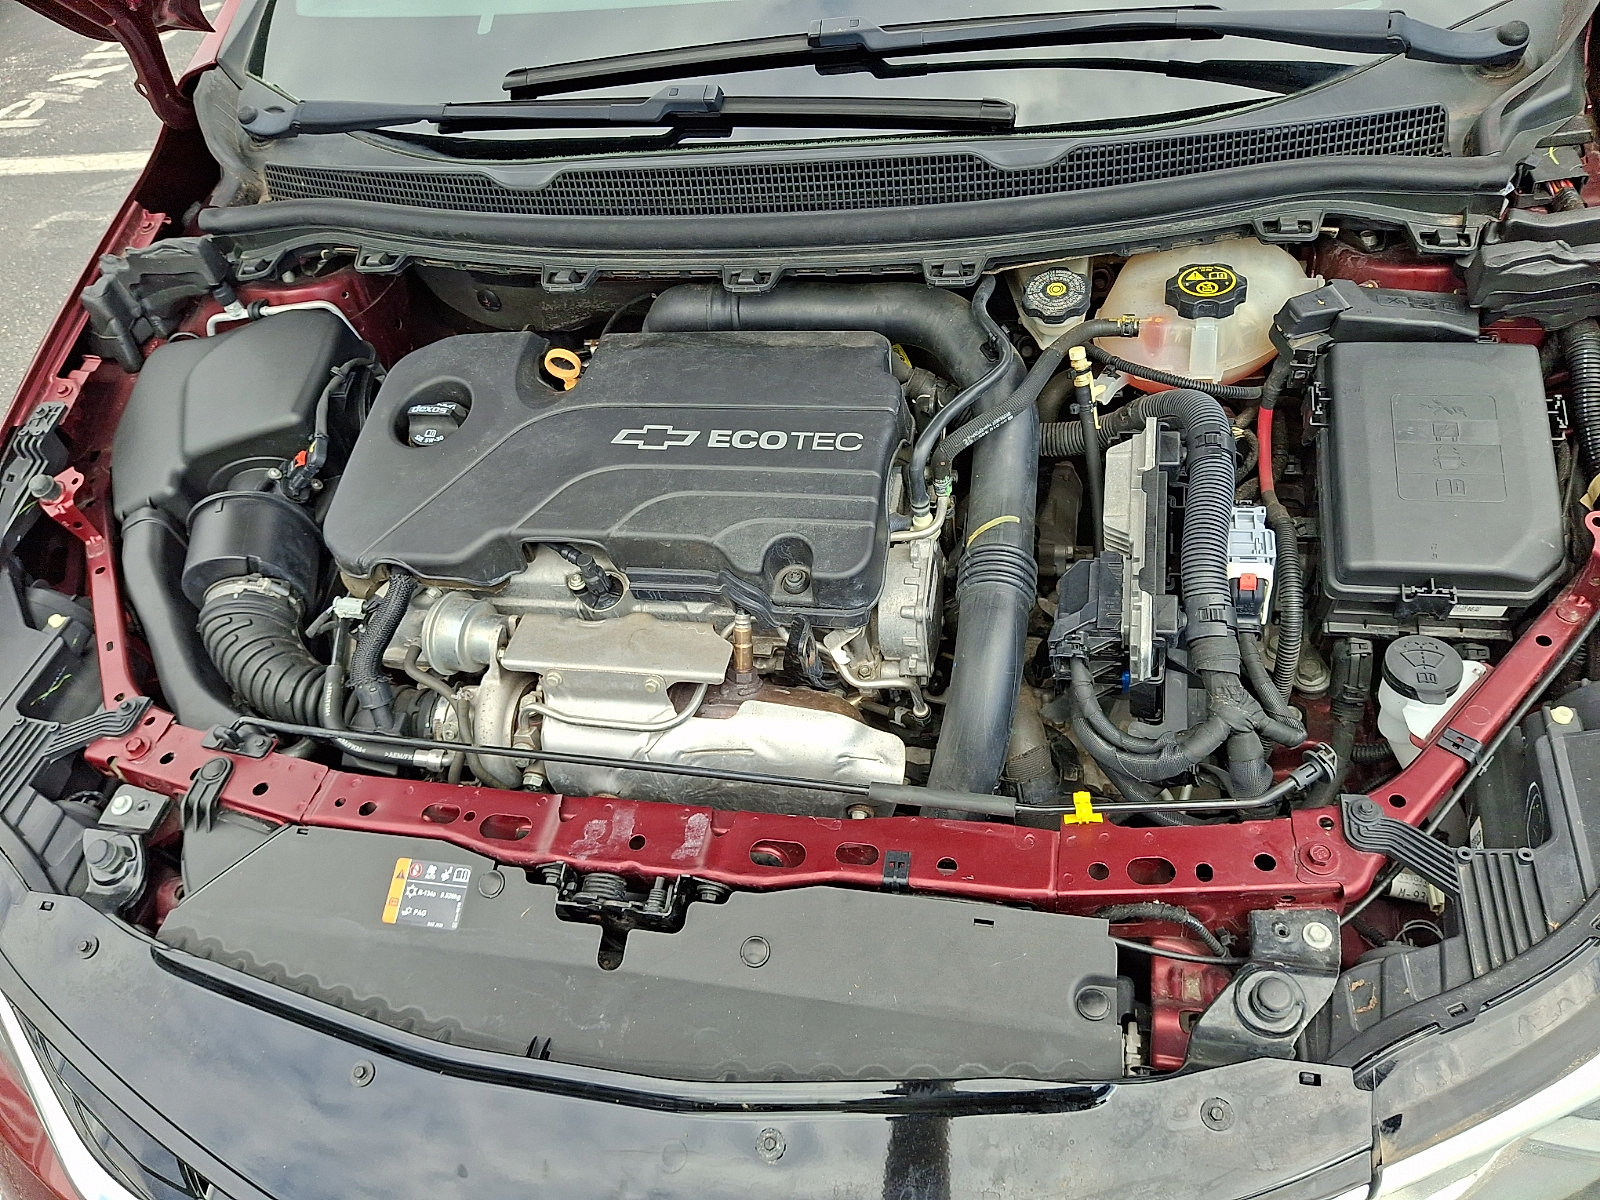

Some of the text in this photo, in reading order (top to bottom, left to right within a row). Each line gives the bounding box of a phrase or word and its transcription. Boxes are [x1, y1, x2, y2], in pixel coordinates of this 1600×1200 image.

[411, 405, 448, 413] dexos
[707, 430, 864, 451] ECOTEC
[413, 909, 427, 917] PAG
